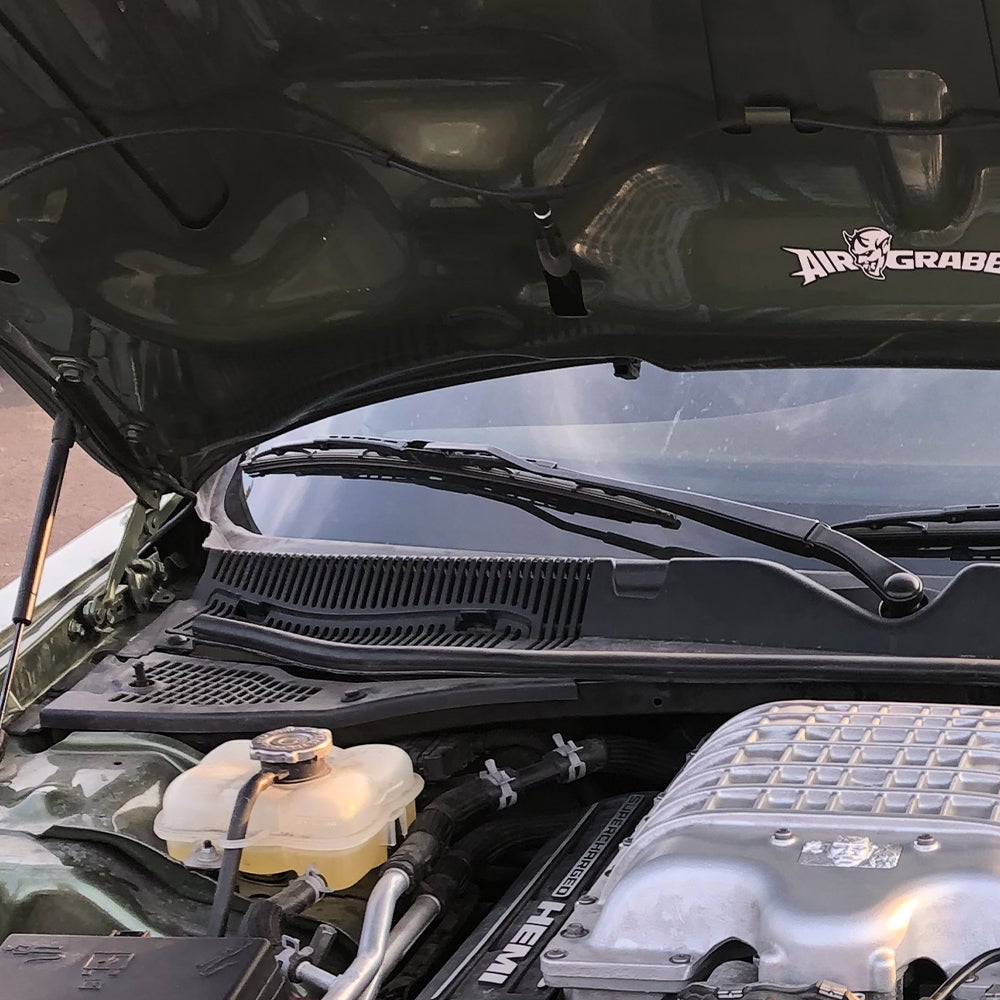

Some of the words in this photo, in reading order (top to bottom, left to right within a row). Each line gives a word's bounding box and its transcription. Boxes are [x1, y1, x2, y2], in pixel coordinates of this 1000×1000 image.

[782, 246, 856, 286] AIR
[553, 794, 643, 897] SUPERCHARGED
[478, 900, 566, 985] HEMI
